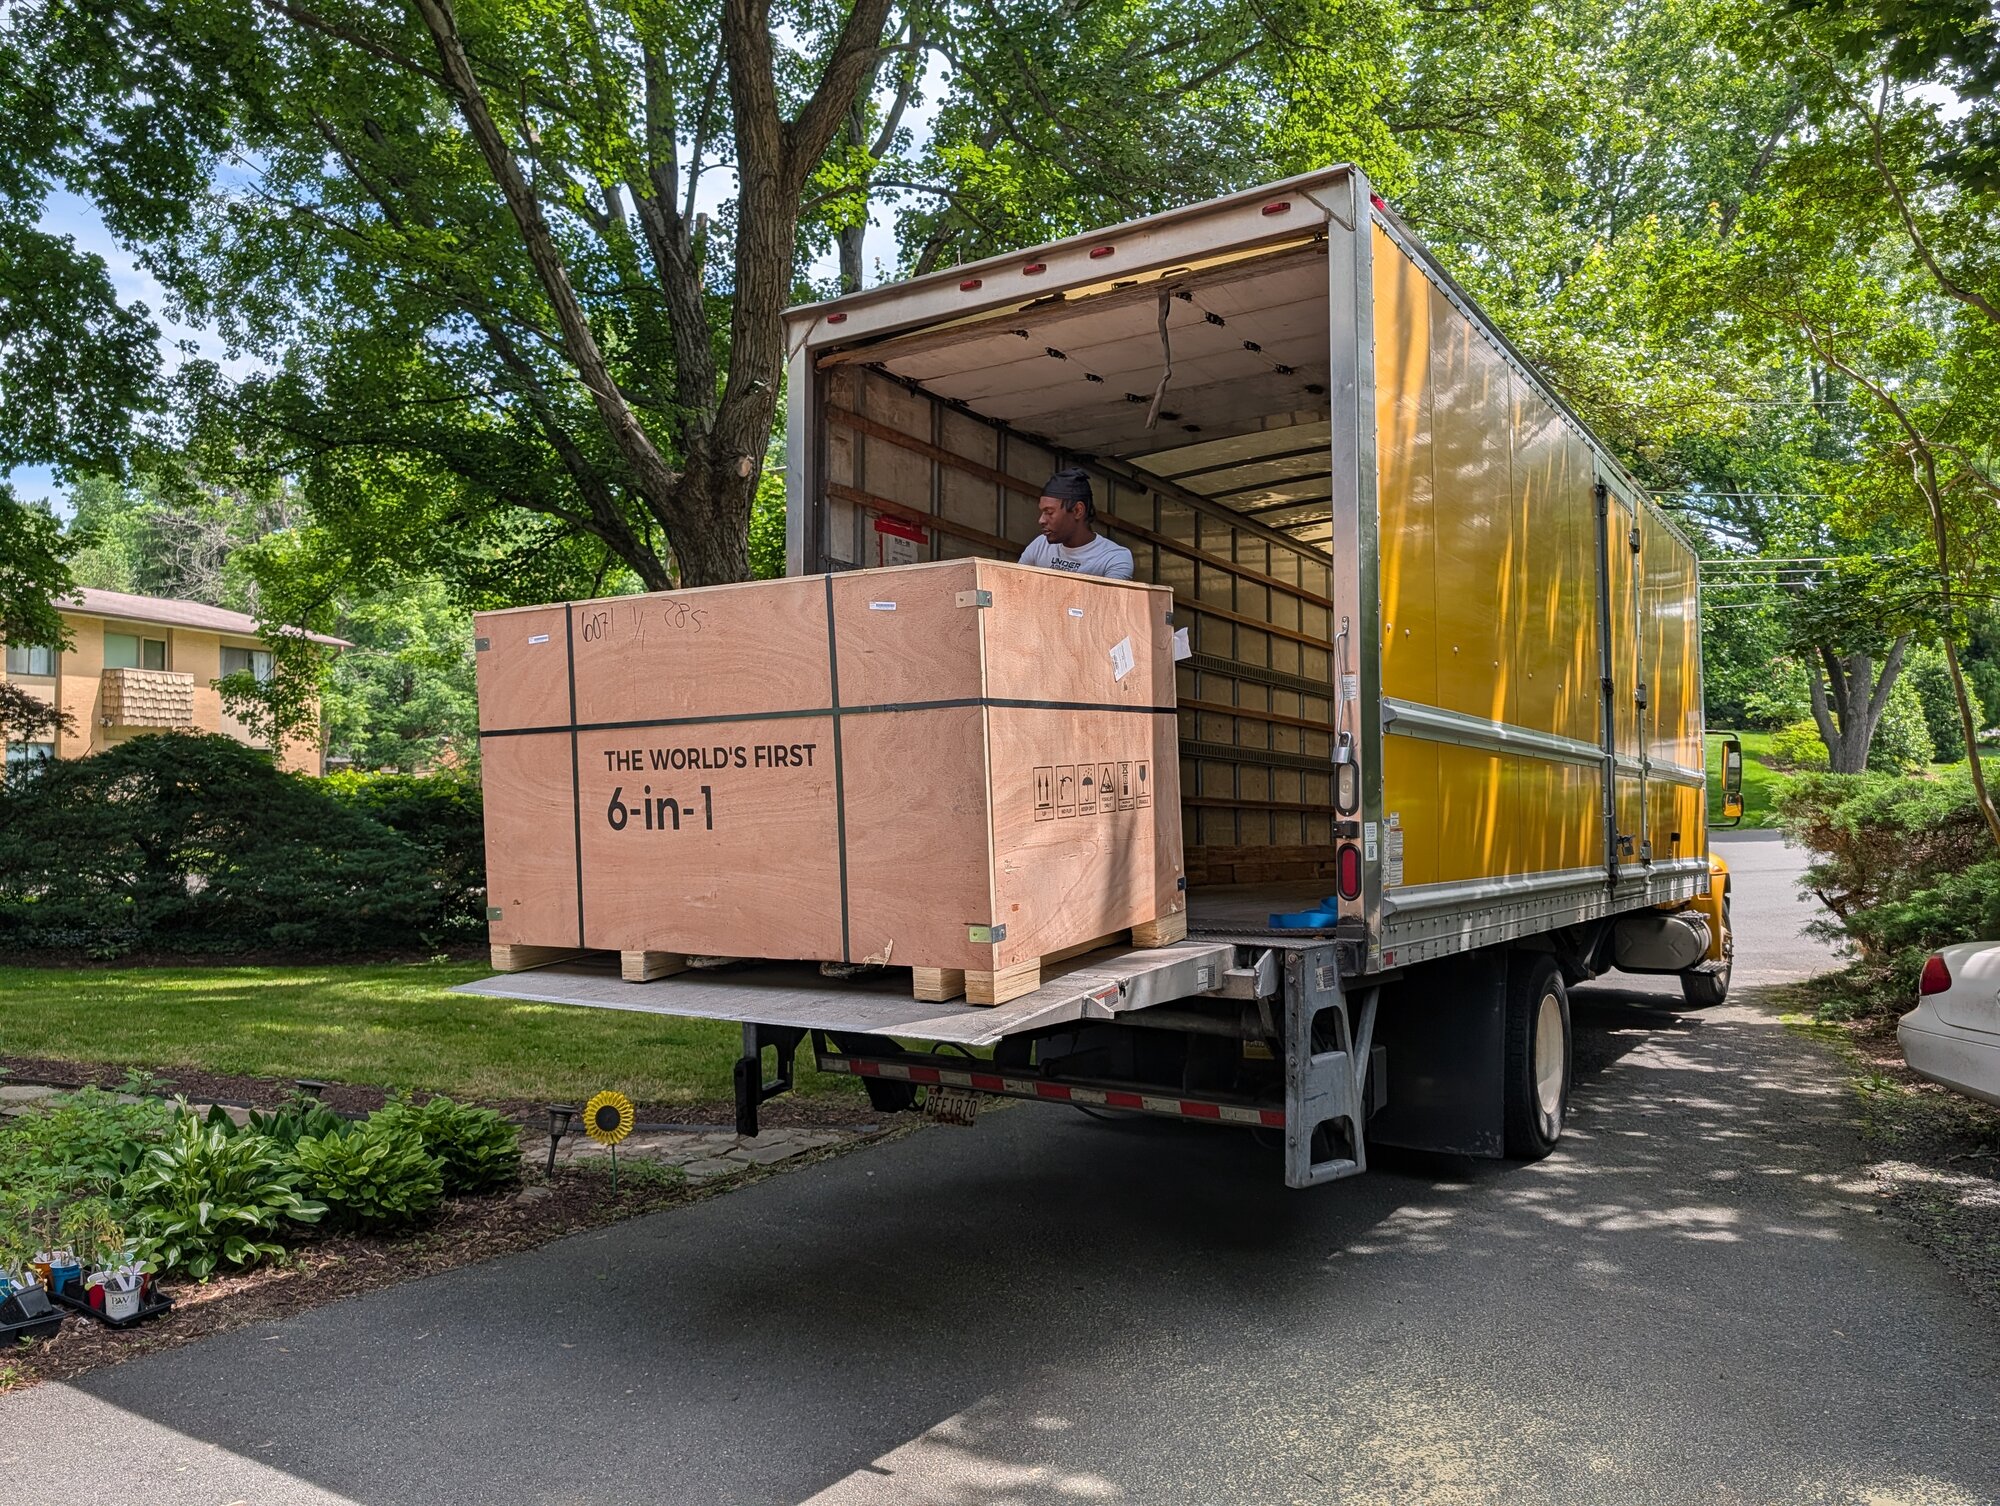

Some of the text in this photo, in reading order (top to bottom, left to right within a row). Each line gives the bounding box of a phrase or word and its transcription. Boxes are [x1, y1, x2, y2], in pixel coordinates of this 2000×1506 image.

[1051, 557, 1081, 569] UNDER
[604, 744, 816, 771] THE WORLD'S FIRST
[607, 785, 713, 831] 6-in-1
